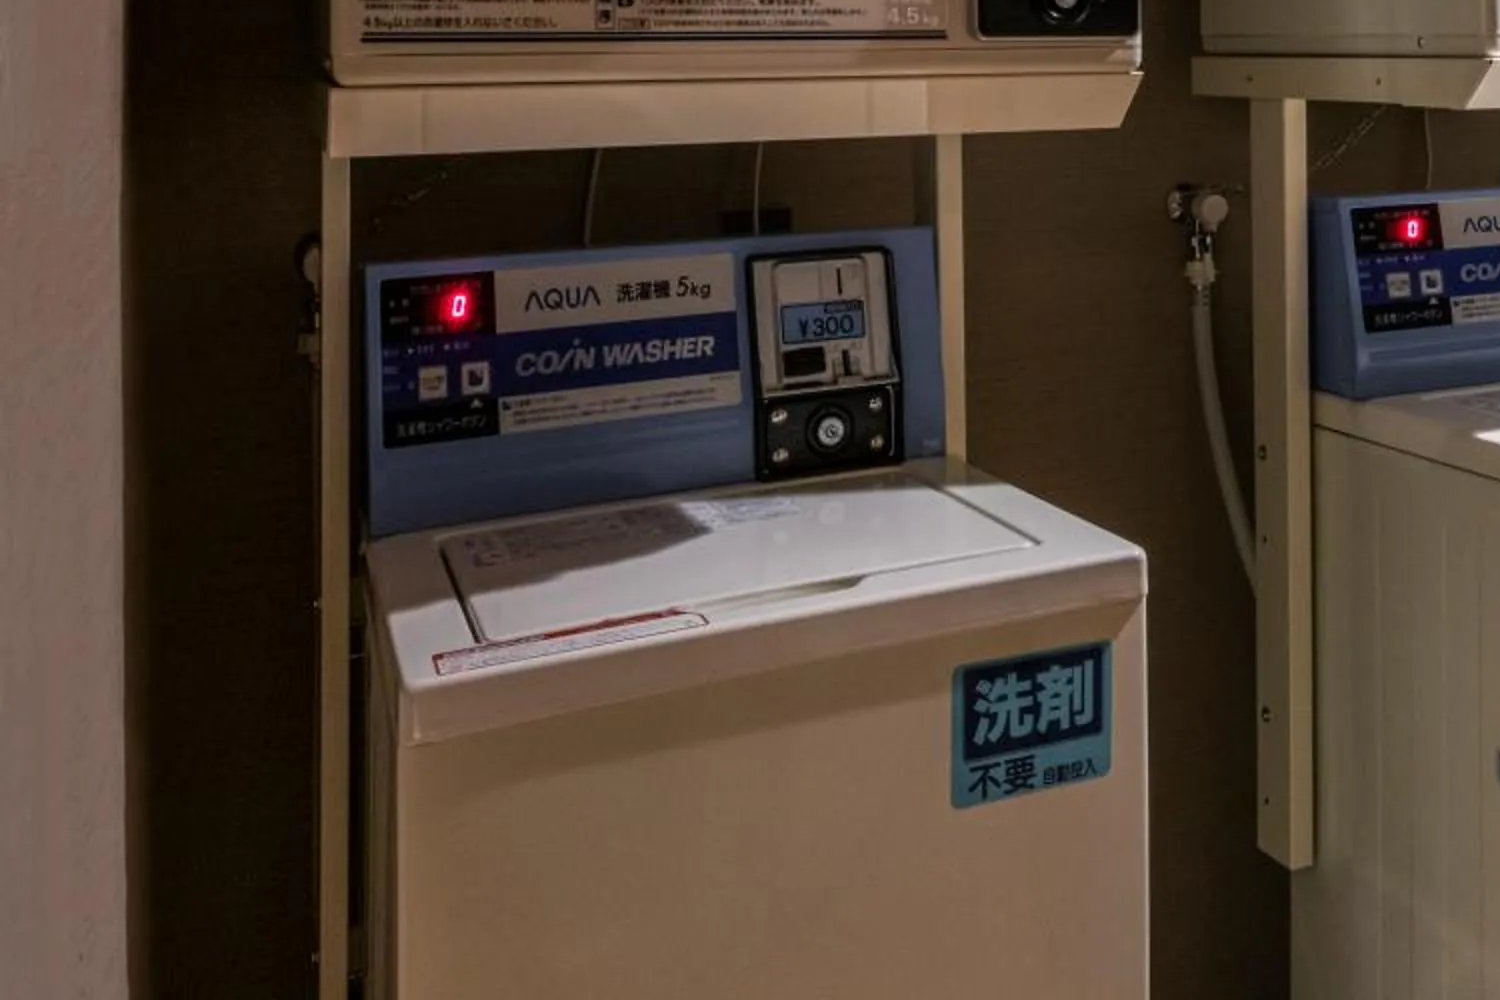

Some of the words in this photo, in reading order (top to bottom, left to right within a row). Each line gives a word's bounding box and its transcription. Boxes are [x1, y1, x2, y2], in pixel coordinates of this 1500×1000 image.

[1407, 220, 1419, 239] 0
[451, 295, 467, 317] 0
[524, 287, 602, 313] AQUA
[616, 279, 672, 304] 洗濯機
[675, 275, 712, 299] 5kg
[604, 335, 716, 367] WASHER
[973, 659, 1095, 746] 洗剤
[968, 754, 1036, 800] 不要
